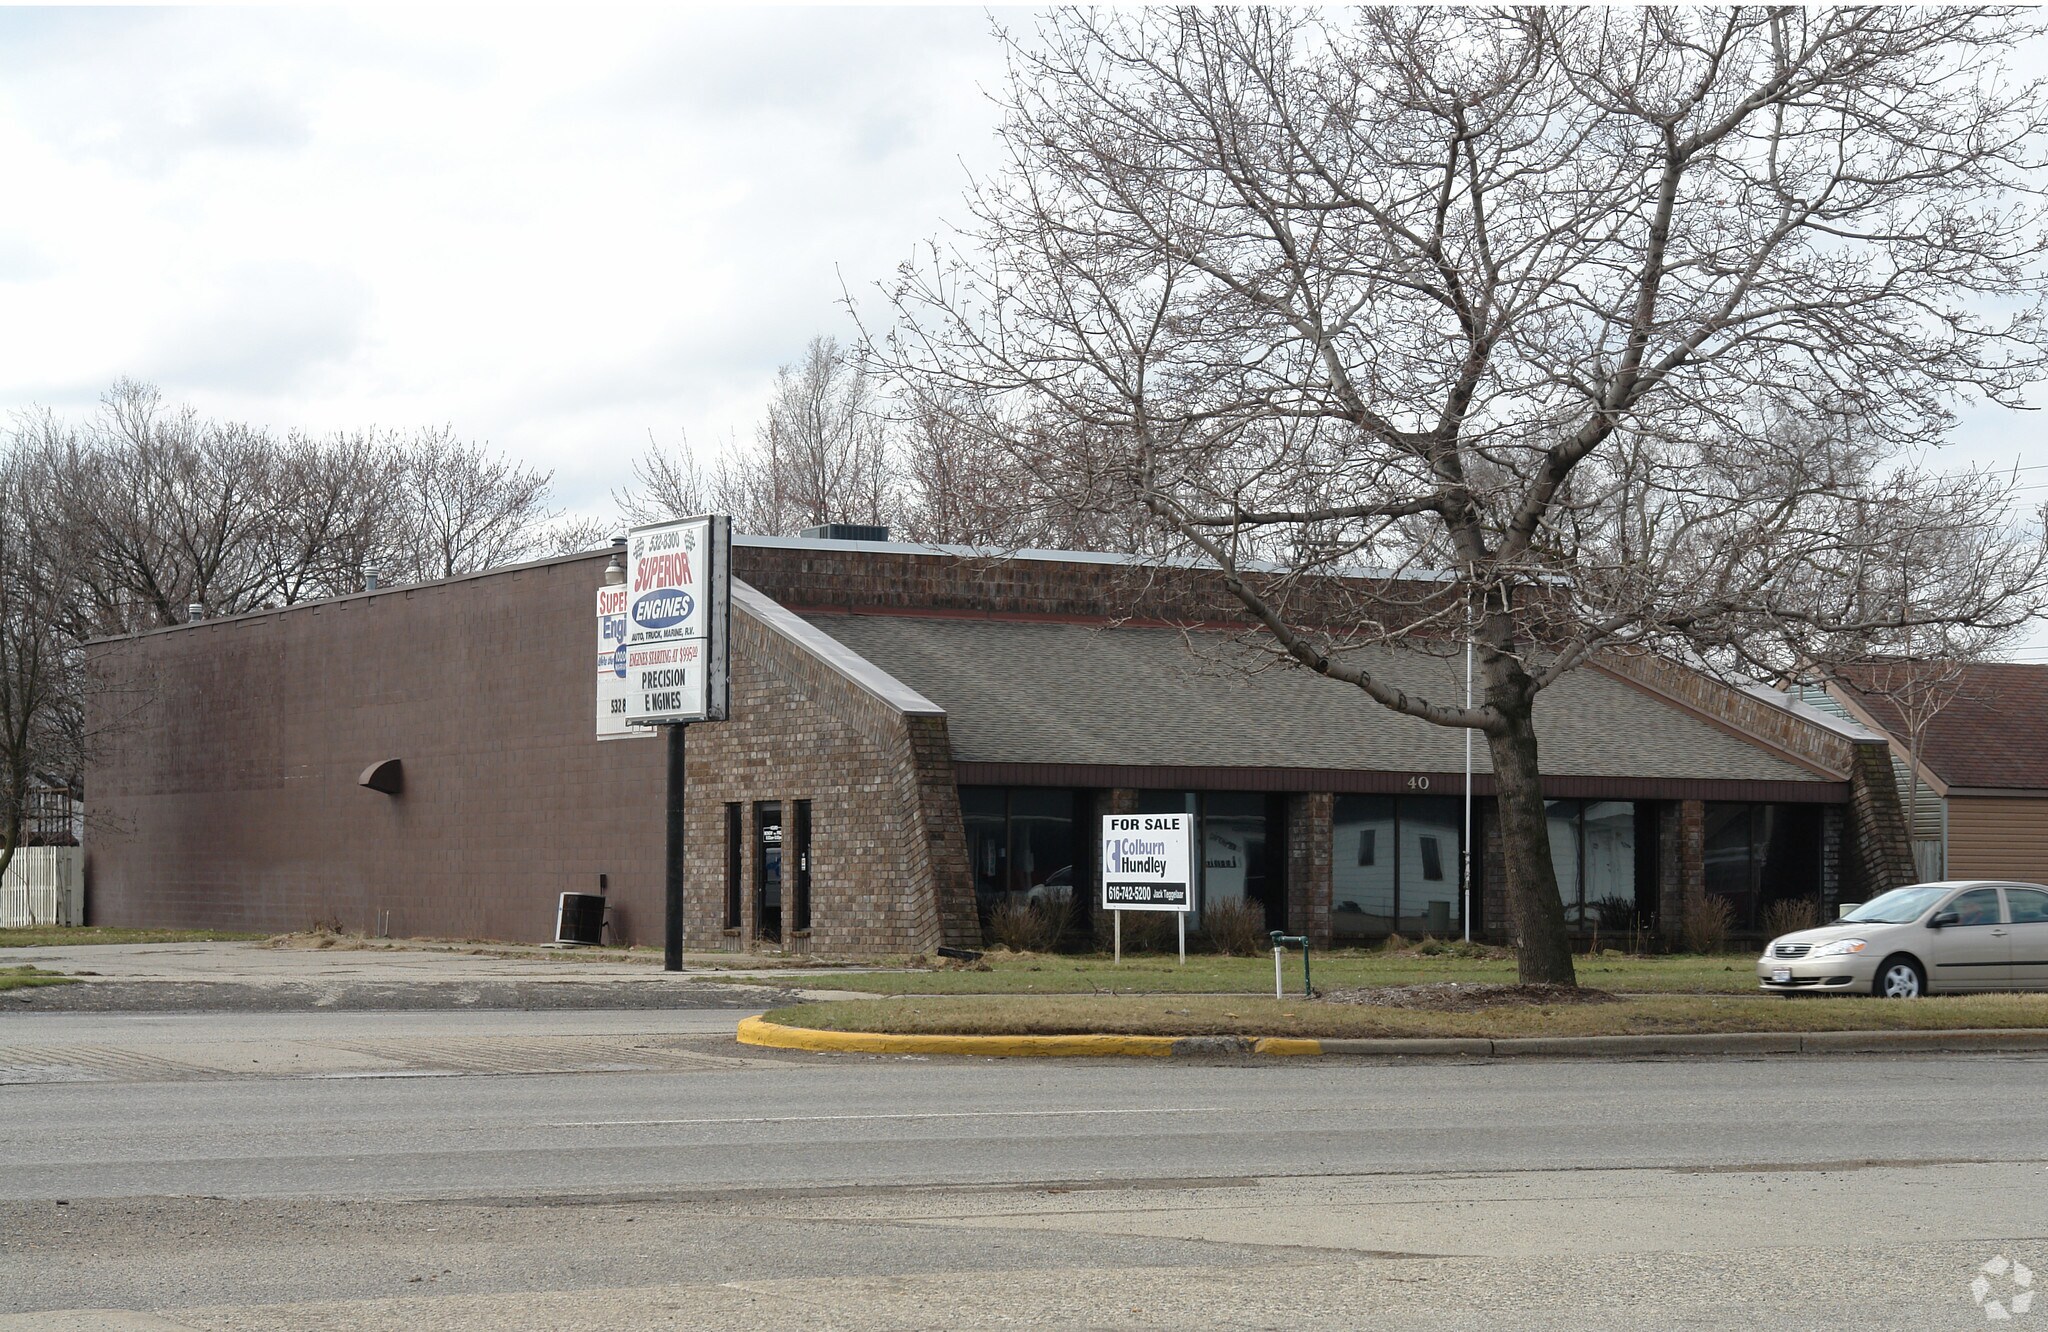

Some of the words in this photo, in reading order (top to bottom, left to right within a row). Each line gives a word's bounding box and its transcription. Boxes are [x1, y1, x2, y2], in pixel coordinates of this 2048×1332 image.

[649, 532, 680, 552] 532-8300
[634, 552, 693, 592] SUPERIOR
[635, 595, 691, 621] ENGINES
[642, 668, 686, 690] PRECISION
[1407, 776, 1430, 790] 40
[1111, 819, 1140, 831] FOR
[1144, 818, 1180, 830] SALE
[1122, 838, 1165, 855] Colburn
[1122, 856, 1167, 878] Hundley
[1108, 885, 1152, 900] 616-742-5200
